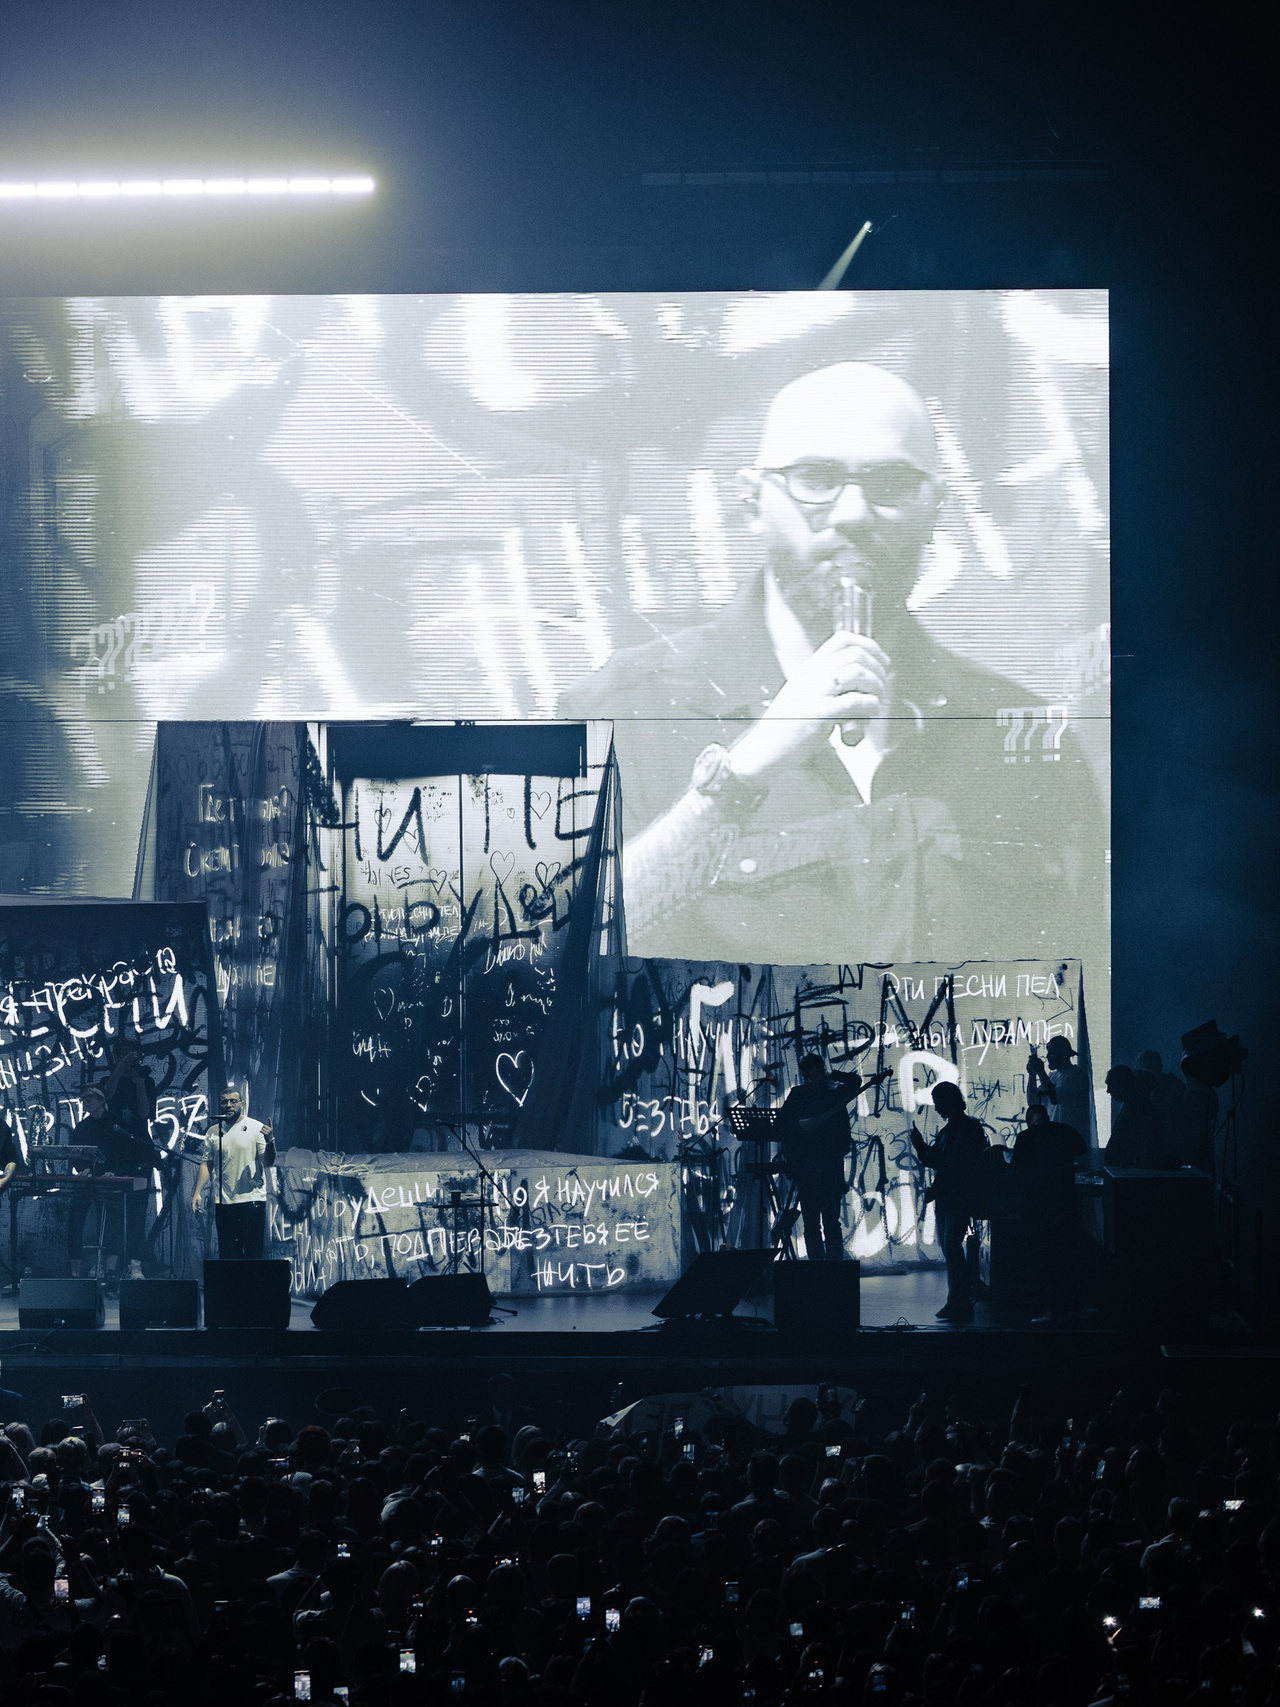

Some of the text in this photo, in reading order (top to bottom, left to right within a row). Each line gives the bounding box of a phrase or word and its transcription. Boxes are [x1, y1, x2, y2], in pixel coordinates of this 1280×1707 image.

[878, 971, 1060, 1001] ЭТИ ПЕСНИ ПЕЛ
[557, 1171, 660, 1218] НАУЧИЛСЯ
